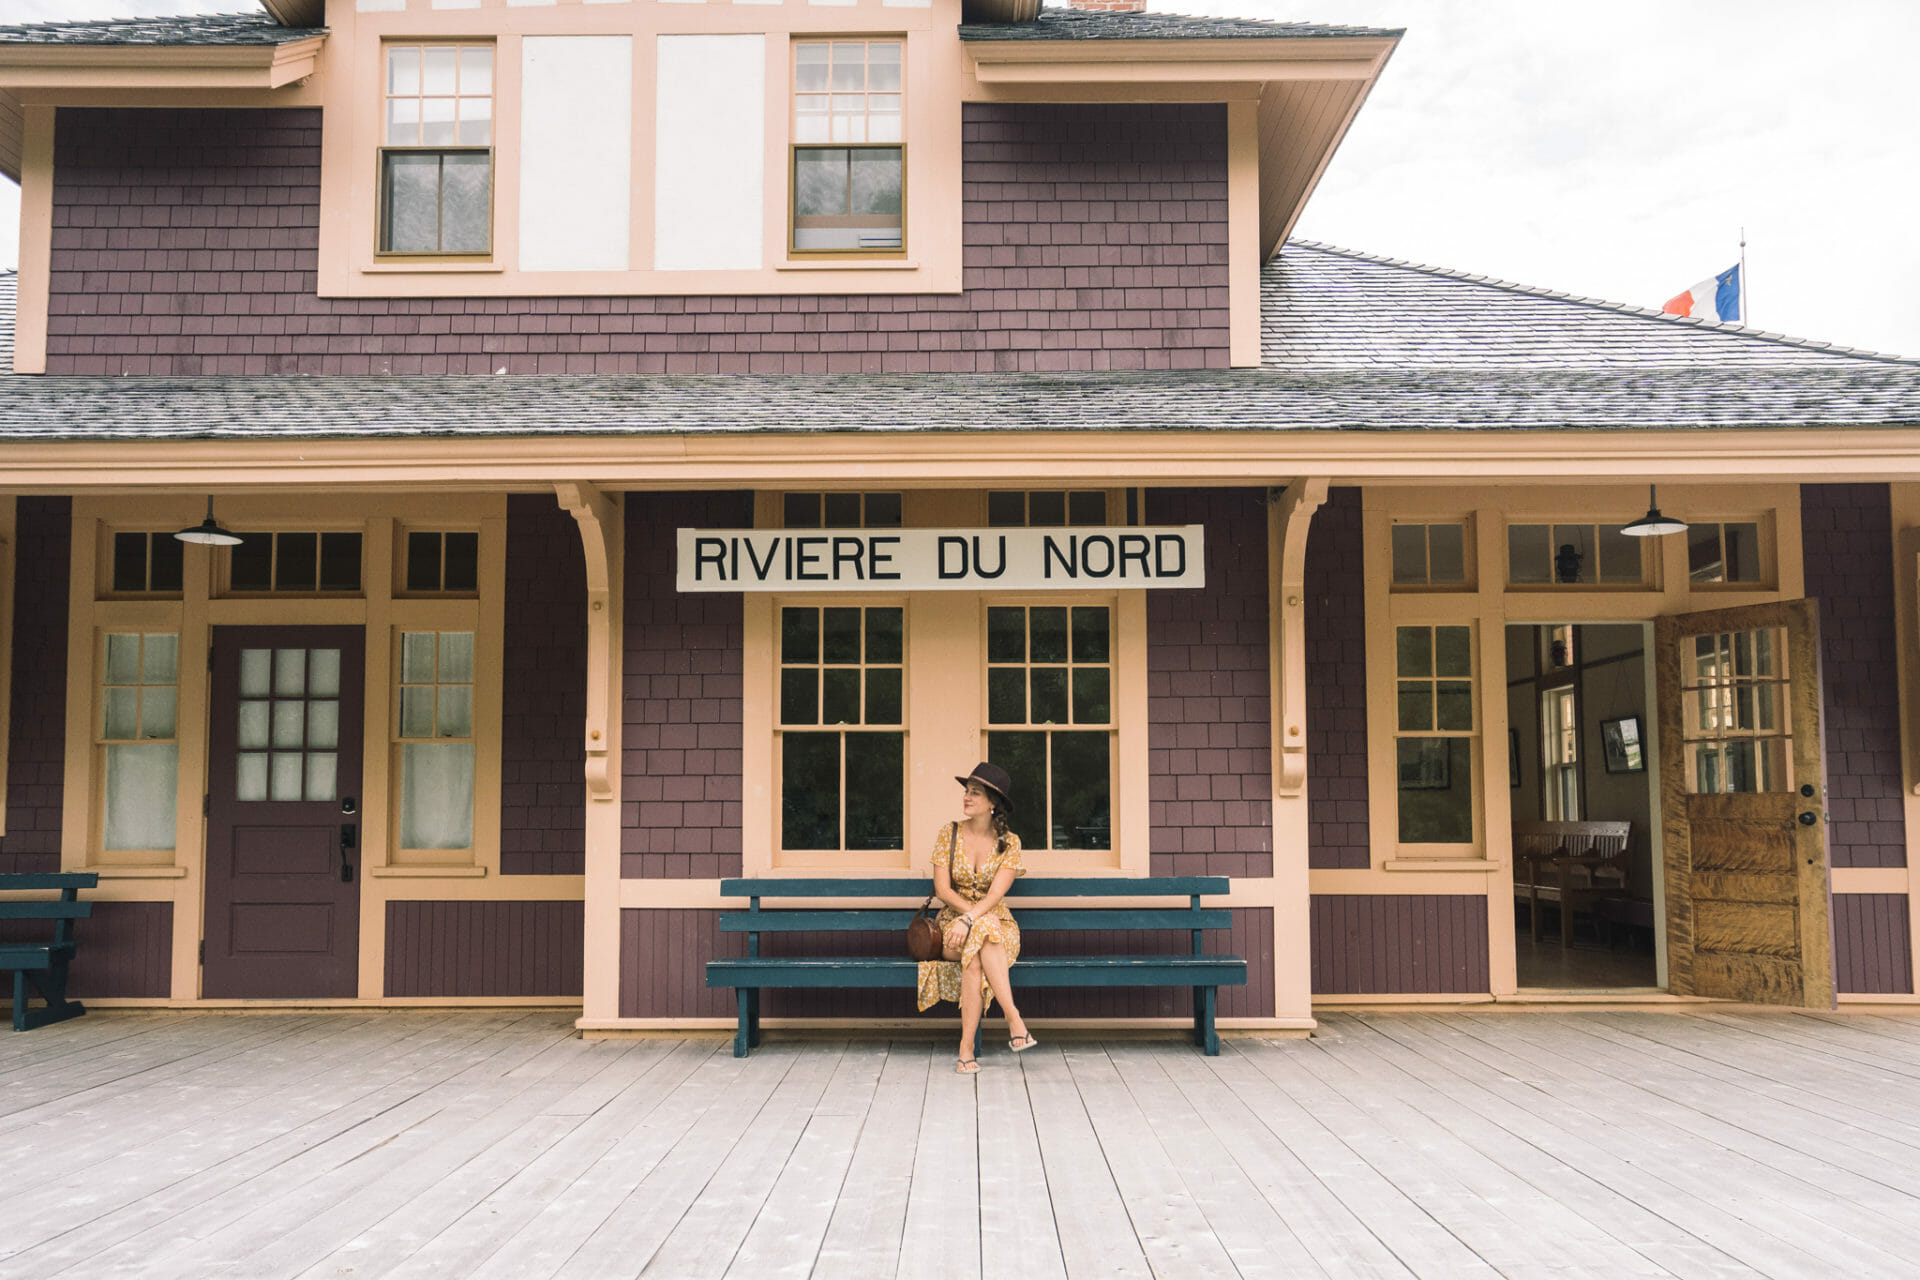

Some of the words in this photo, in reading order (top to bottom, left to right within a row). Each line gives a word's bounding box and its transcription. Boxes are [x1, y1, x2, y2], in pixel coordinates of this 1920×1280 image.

[695, 536, 901, 581] RIVIERE
[937, 535, 1007, 580] DU
[1043, 534, 1186, 579] NORD
